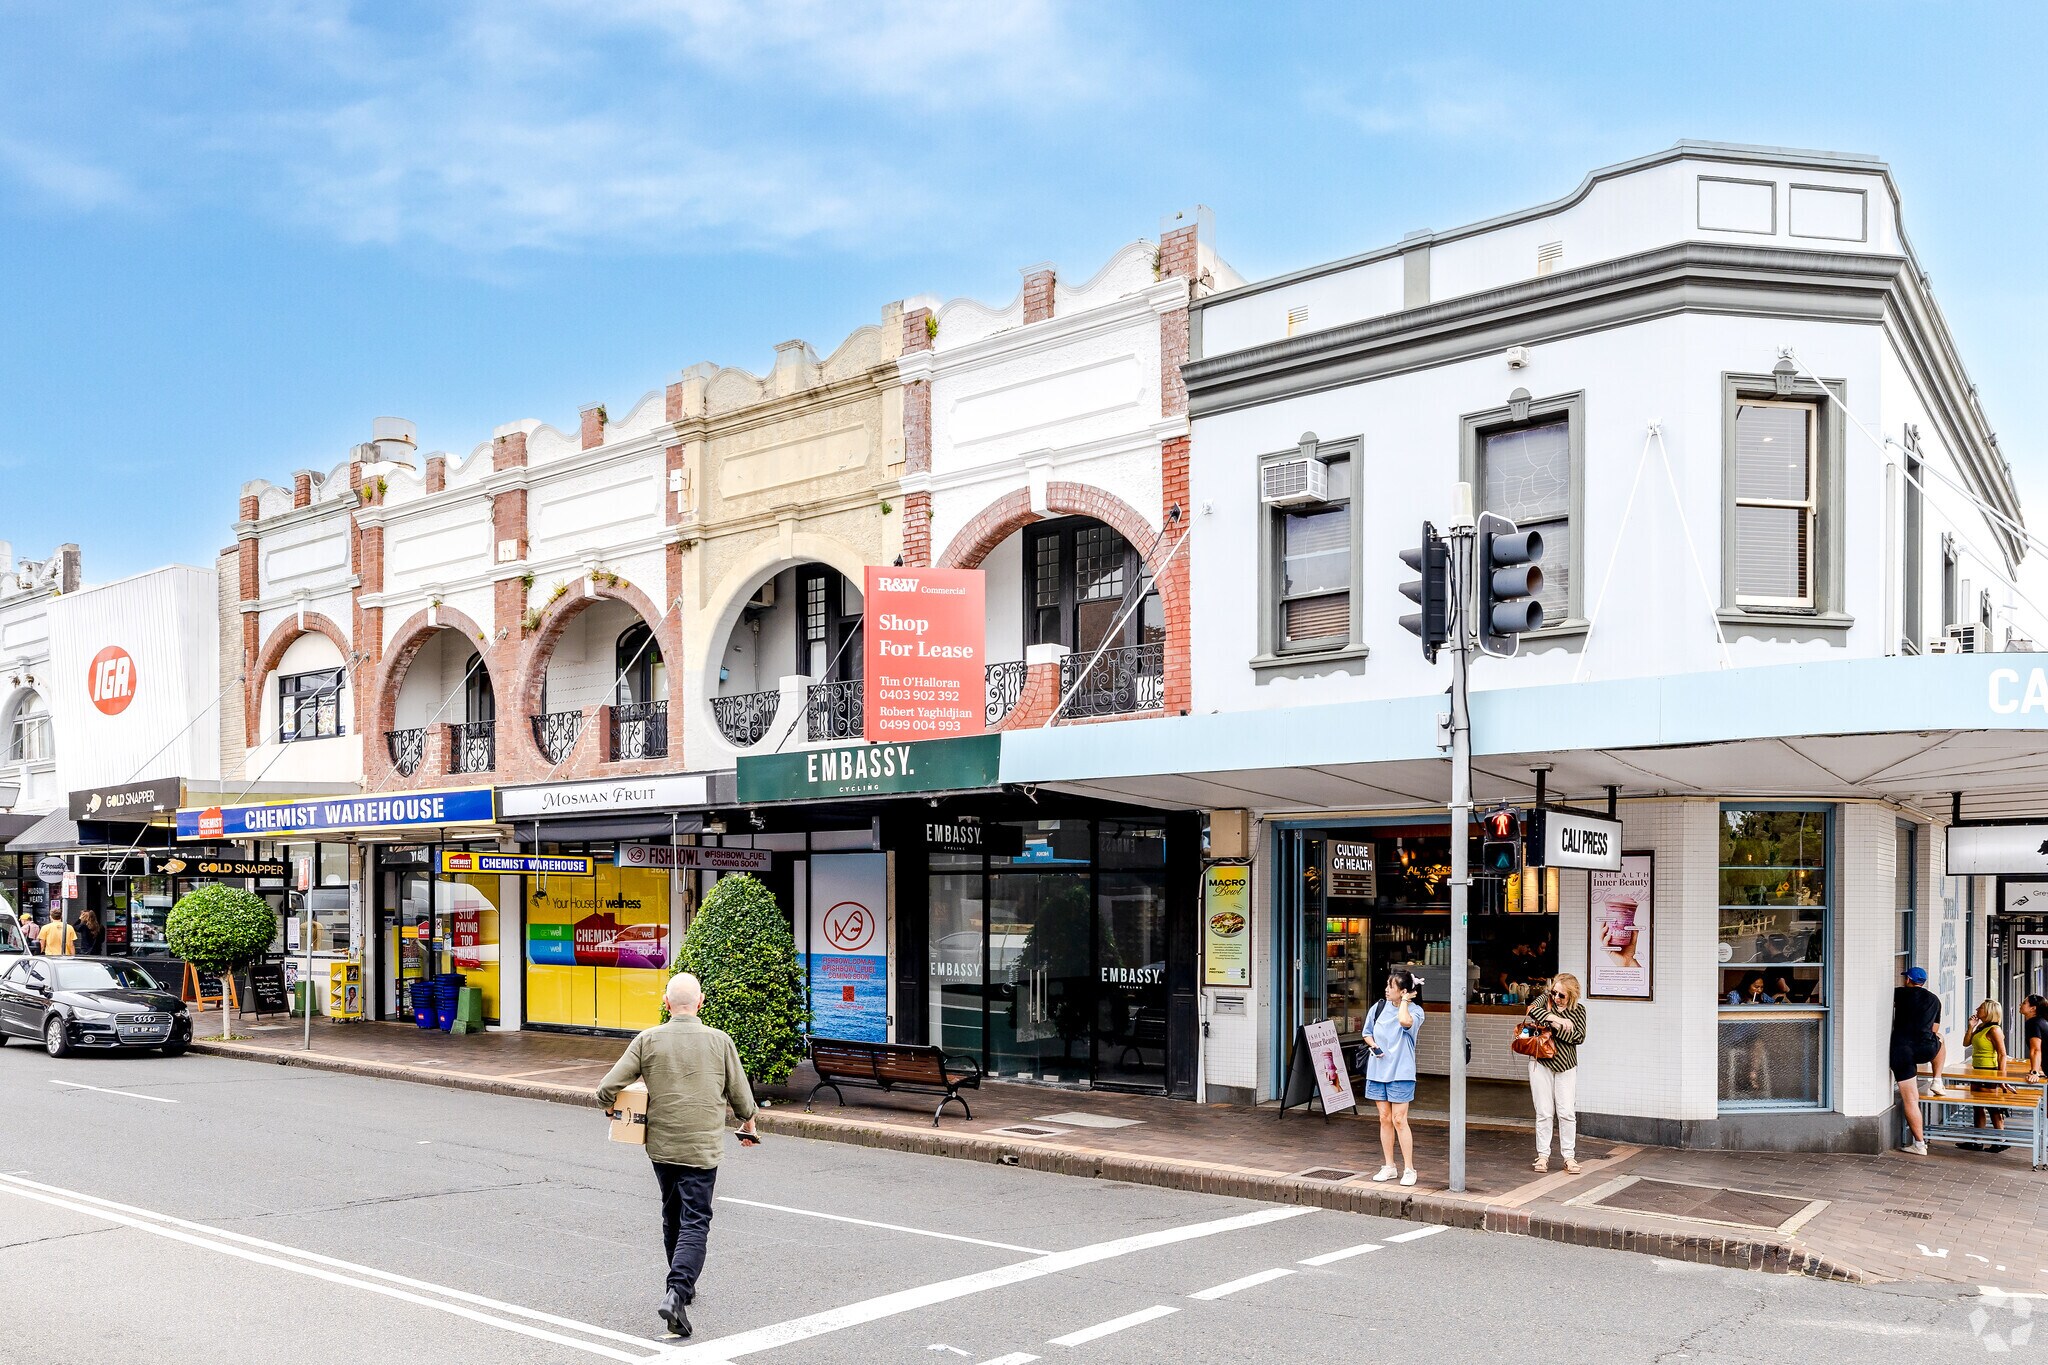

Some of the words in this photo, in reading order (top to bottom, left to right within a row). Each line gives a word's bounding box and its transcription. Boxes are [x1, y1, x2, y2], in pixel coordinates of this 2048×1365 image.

[878, 577, 919, 593] R&W
[921, 586, 966, 595] Commercial
[879, 614, 929, 635] Shop
[879, 640, 913, 657] For
[917, 641, 973, 658] Lease
[94, 656, 130, 702] IGA
[879, 676, 900, 686] Tim
[903, 676, 960, 688] O'Halloran
[880, 689, 911, 700] 0403
[913, 690, 935, 701] 902
[937, 691, 959, 701] 392
[880, 706, 915, 717] Robert
[879, 719, 910, 730] 0499
[913, 720, 936, 730] 004
[938, 721, 961, 731] 993
[807, 745, 915, 783] EMBASSY.
[839, 784, 879, 793] CYCLING
[105, 793, 125, 808] GOLD
[125, 789, 155, 806] SNAPPER
[245, 806, 318, 830] CHEMIST
[325, 797, 445, 824] WAREHOUSE
[199, 817, 222, 829] CHEMIST
[926, 823, 983, 844] EMBASSY.
[1562, 827, 1581, 854] CALI
[1582, 831, 1608, 856] PRESS
[704, 850, 767, 861] @FISHBOWL_FUEL
[1336, 844, 1369, 858] CULTURE
[40, 862, 66, 870] Proudly
[198, 862, 233, 874] GOLD
[234, 862, 284, 875] SNAPPER
[482, 857, 525, 870] CHEMIST
[527, 859, 585, 872] WAREHOUSE
[711, 859, 740, 867] COMING
[740, 860, 759, 868] SOON
[1333, 857, 1344, 870] OF
[1345, 858, 1373, 871] HEALTH
[1208, 879, 1246, 887] MACRO
[1593, 879, 1617, 887] Inner
[1619, 878, 1649, 888] Beauty
[1213, 885, 1244, 897] Bowl
[552, 897, 568, 909] Your
[570, 897, 595, 910] House
[595, 897, 604, 909] of
[605, 898, 642, 910] wellness
[458, 909, 475, 920] STOP
[455, 921, 478, 934] PAYING
[460, 934, 473, 946] TOO
[575, 928, 617, 943] CHEMIST
[456, 948, 477, 960] MUCH!
[575, 944, 616, 953] WAREHOUSE
[827, 972, 852, 980] COMING
[852, 973, 870, 981] SOON
[1101, 967, 1162, 984] EMBASSY.
[1309, 1040, 1323, 1049] Inner
[1322, 1036, 1338, 1047] Beauty
